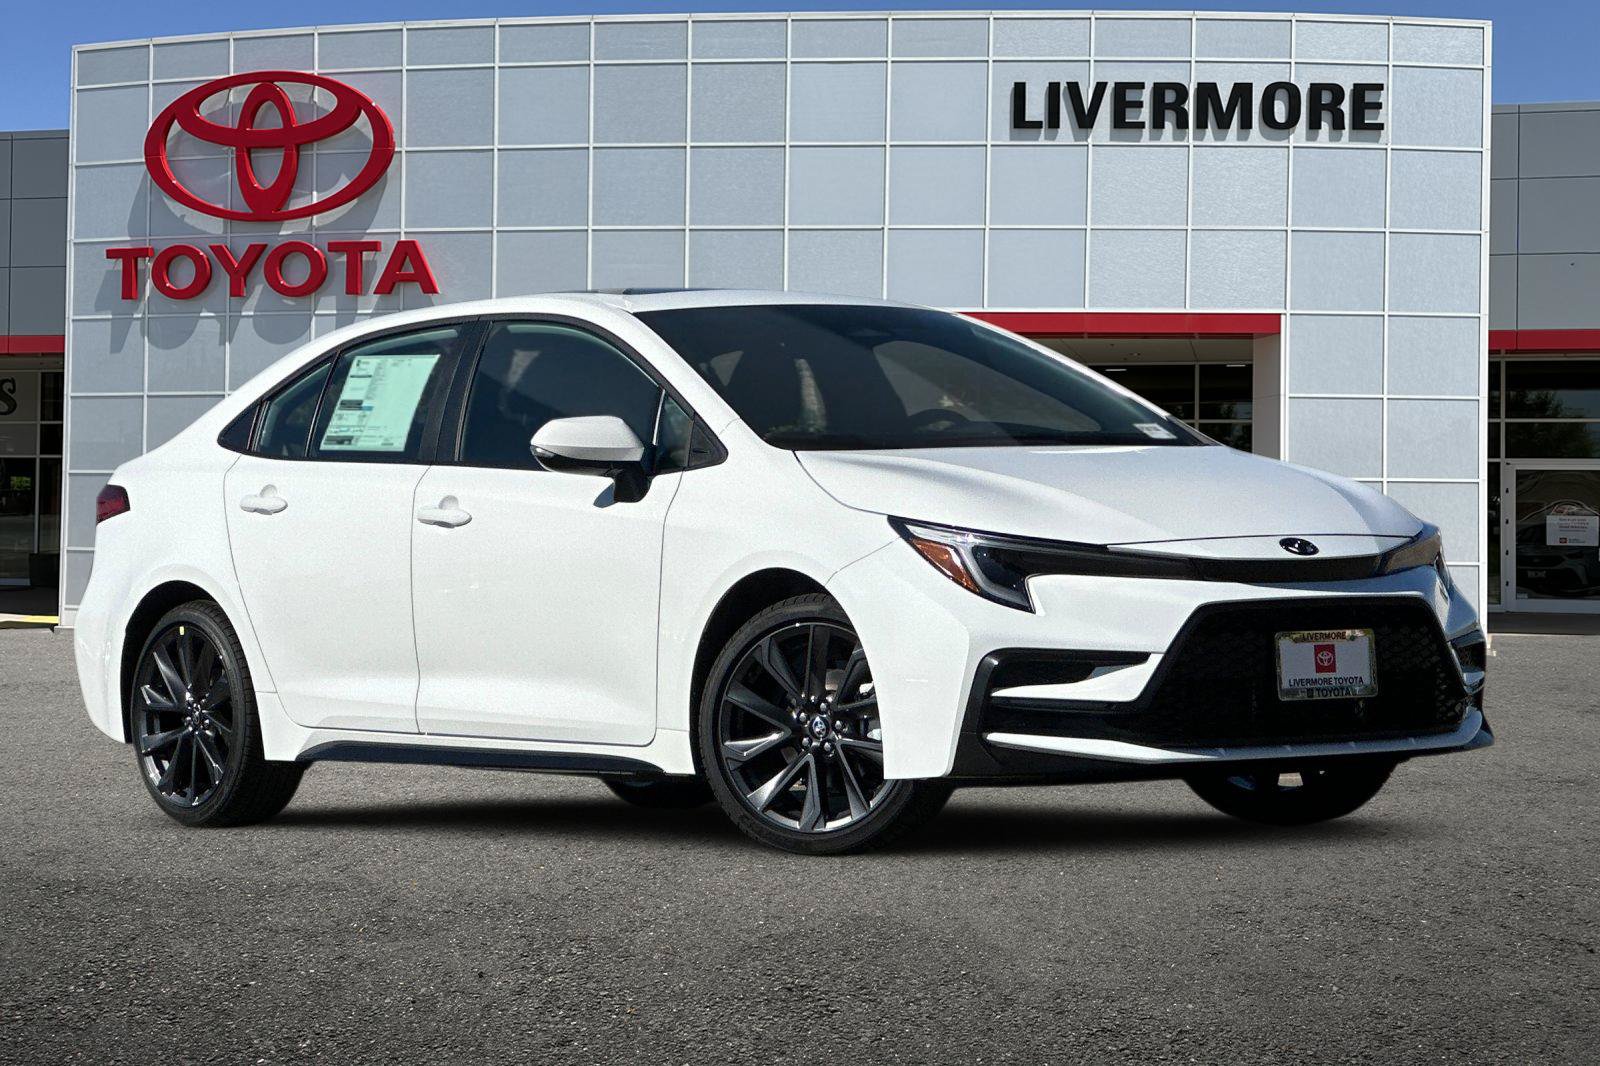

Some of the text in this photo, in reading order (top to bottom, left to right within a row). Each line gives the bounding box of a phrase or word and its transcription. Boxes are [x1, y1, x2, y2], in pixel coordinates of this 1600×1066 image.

[1012, 80, 1385, 131] LIVERMORE
[106, 239, 441, 301] TOYOTA
[1303, 631, 1347, 640] LIVERMORE
[1289, 676, 1364, 687] LIVERMORE TOYOTA
[1316, 687, 1350, 697] TOYOTA
